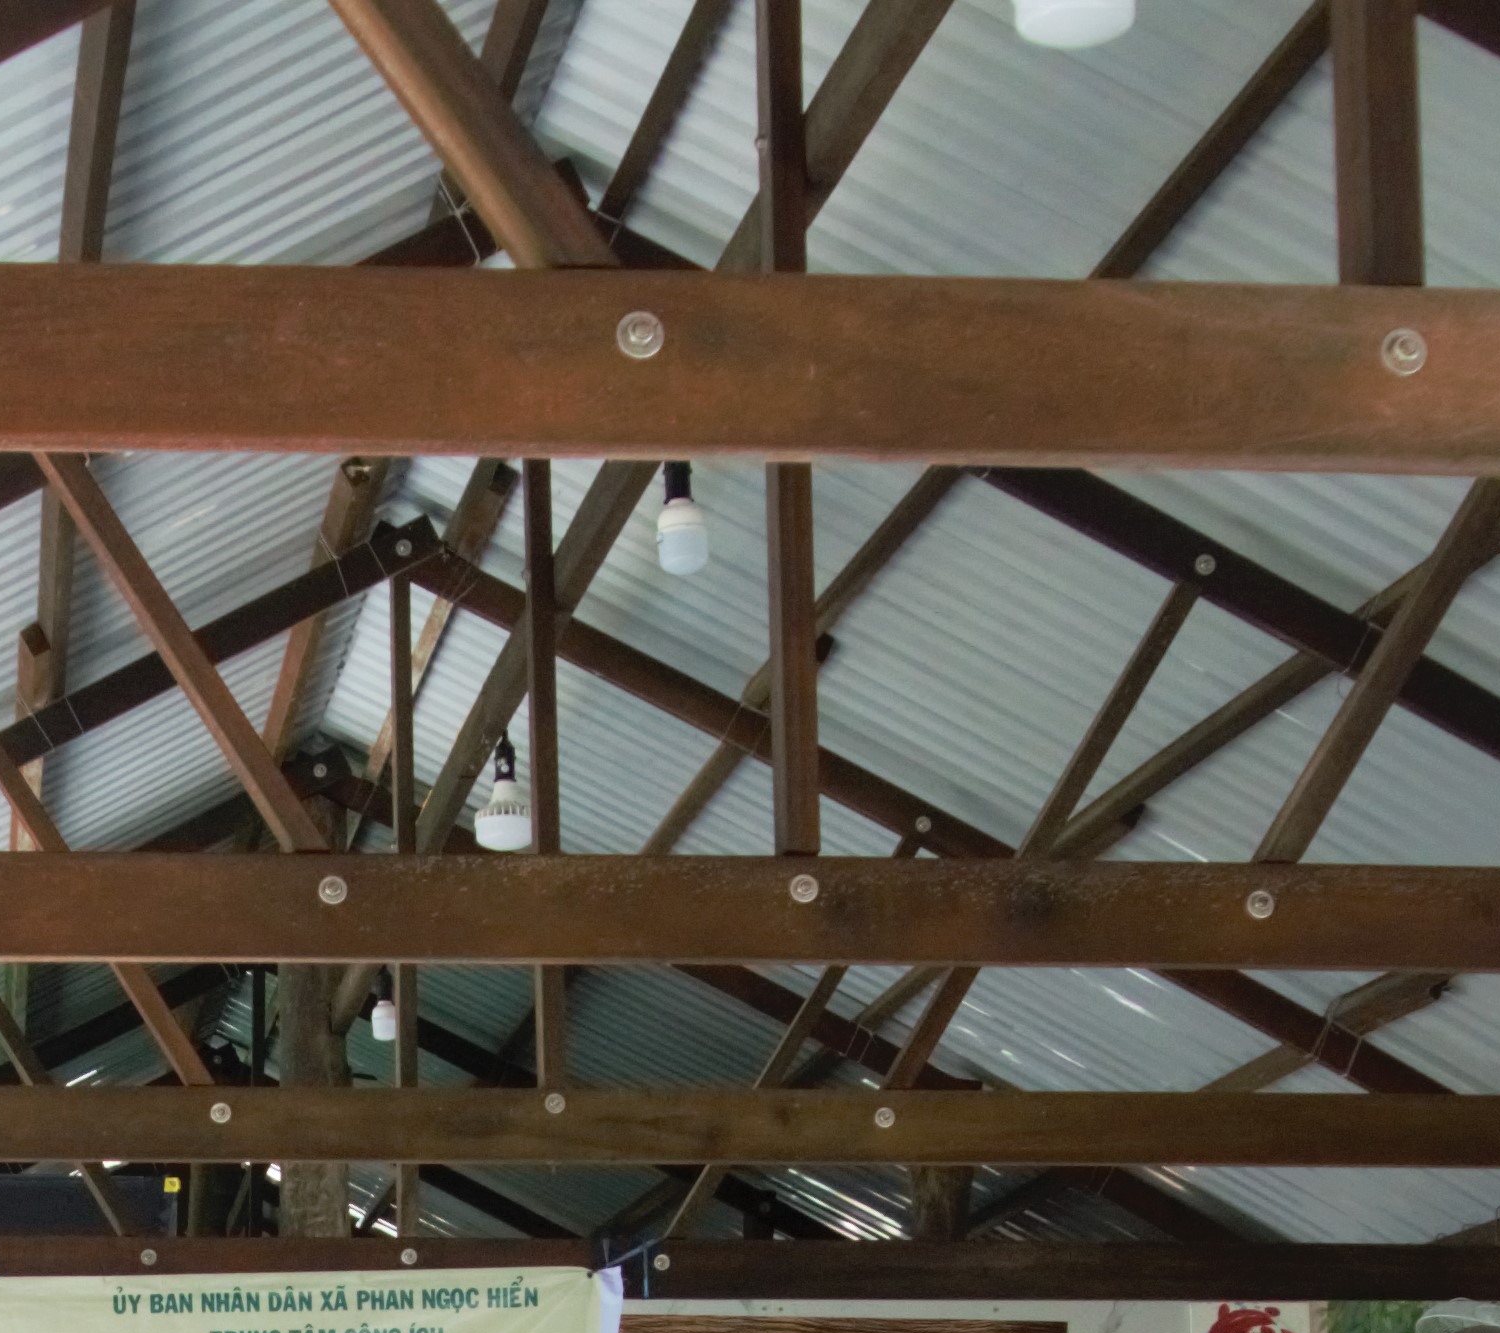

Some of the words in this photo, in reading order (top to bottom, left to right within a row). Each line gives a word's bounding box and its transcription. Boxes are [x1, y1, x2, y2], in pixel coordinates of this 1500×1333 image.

[112, 1286, 142, 1314] ỦY
[149, 1292, 193, 1314] BAN
[200, 1286, 261, 1313] NHÂN
[267, 1285, 313, 1312] DÂN
[320, 1285, 348, 1311] XÃ
[356, 1288, 414, 1311] PHAN
[421, 1287, 480, 1314] NGỌC
[487, 1275, 539, 1308] HIỂN
